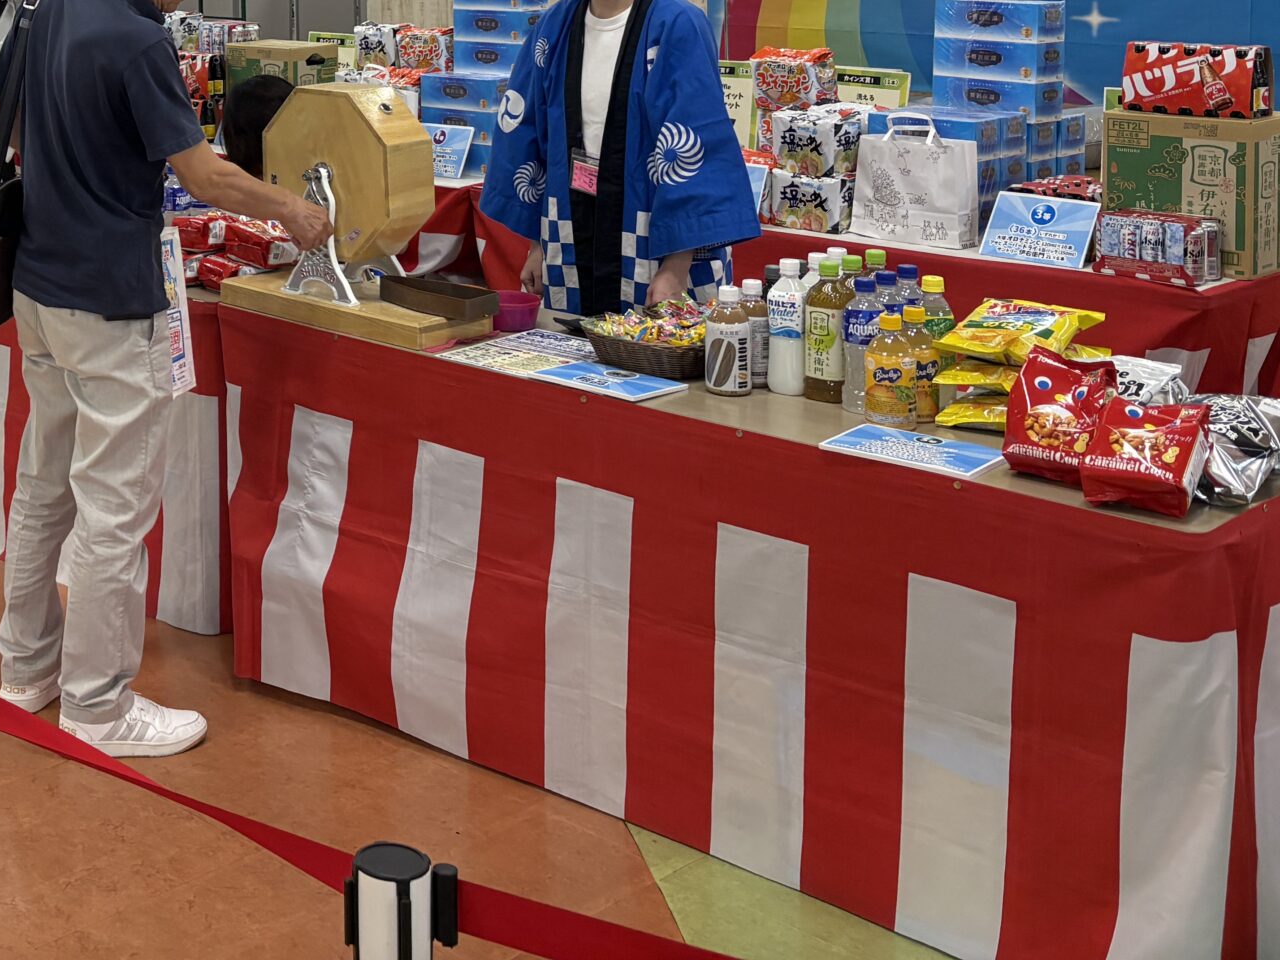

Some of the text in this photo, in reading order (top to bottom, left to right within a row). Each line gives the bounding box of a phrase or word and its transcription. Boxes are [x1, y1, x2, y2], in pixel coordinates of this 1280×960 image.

[756, 72, 811, 93] みそラーメン
[781, 126, 823, 155] 塩らーめん
[1208, 154, 1221, 179] 京都
[780, 181, 828, 212] 塩らーめん
[1035, 210, 1051, 220] 3等
[768, 299, 797, 309] カルピス
[768, 307, 798, 317] Water
[738, 337, 748, 389] DOUTOR
[814, 337, 824, 377] 伊右衛門
[1085, 454, 1139, 472] Caramel
